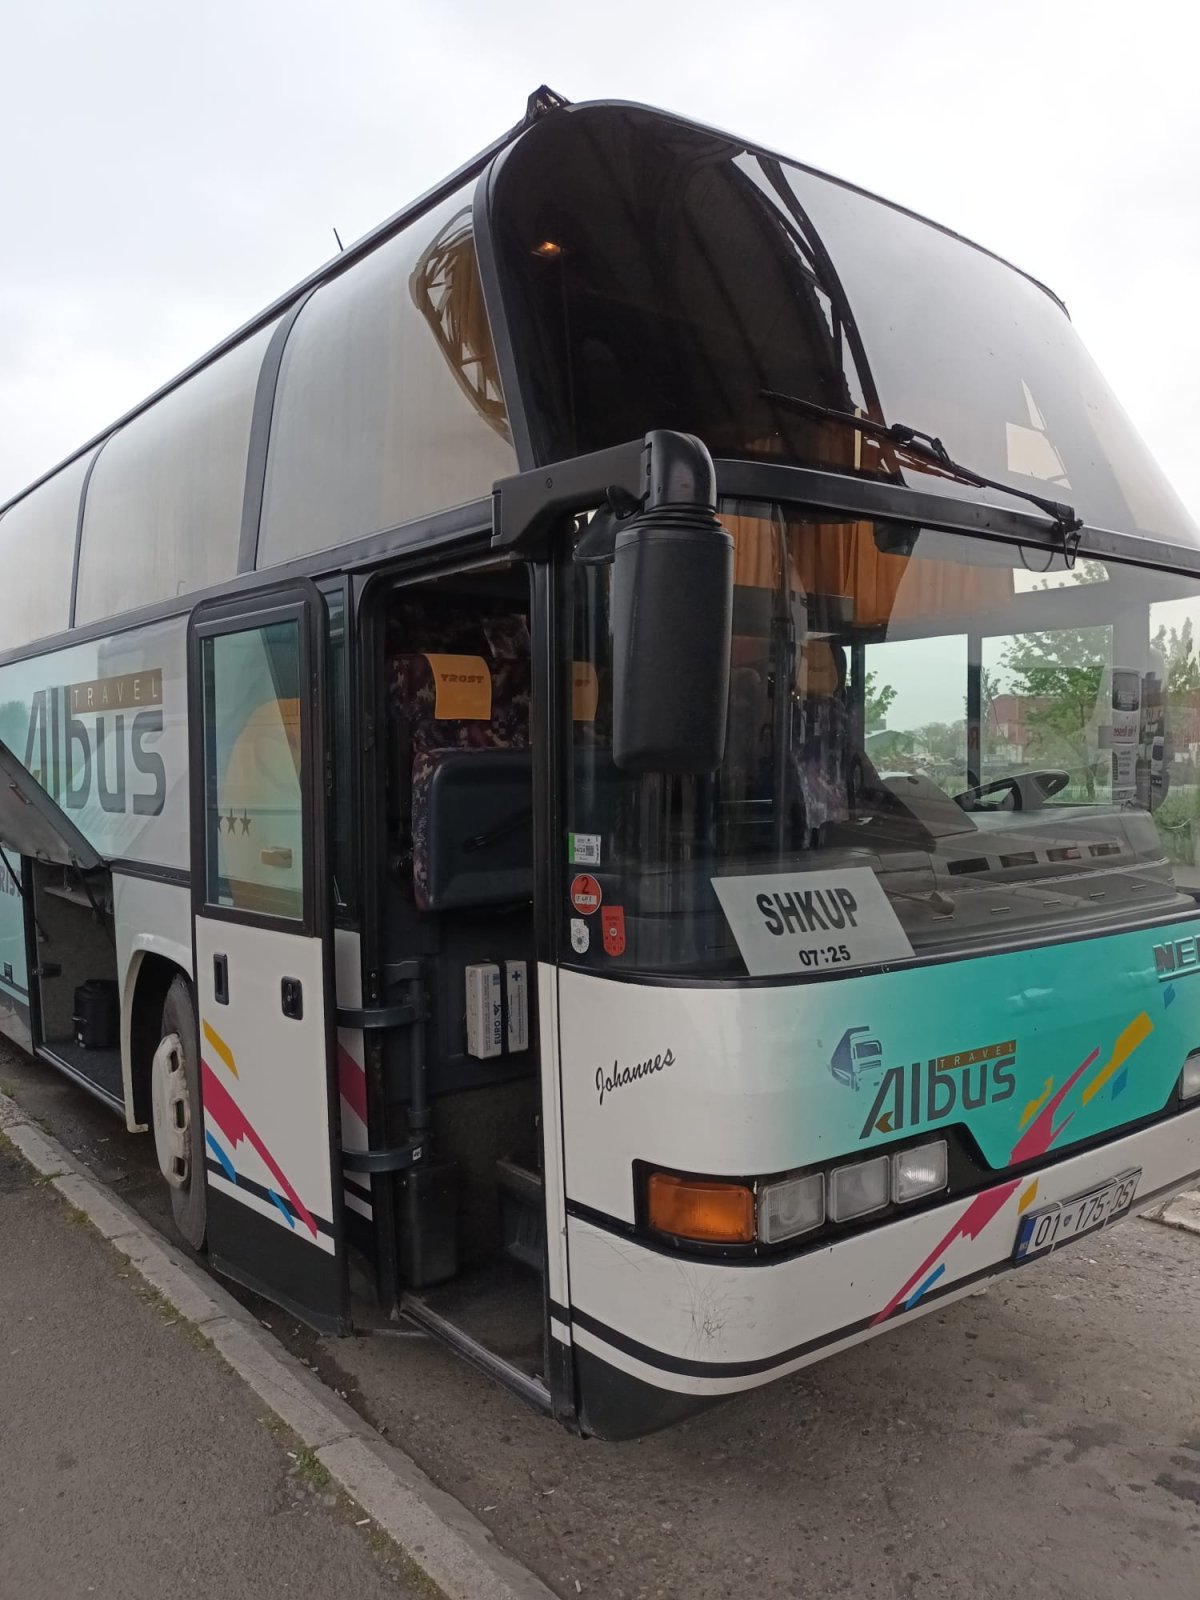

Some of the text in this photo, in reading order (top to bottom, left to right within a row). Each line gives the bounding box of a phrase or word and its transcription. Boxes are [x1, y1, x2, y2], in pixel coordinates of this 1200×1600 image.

[74, 677, 158, 709] TRAVEL
[440, 673, 485, 684] TROST
[24, 686, 167, 816] Albus
[756, 887, 858, 936] SHKUP
[799, 945, 851, 967] 07:25
[1153, 934, 1200, 973] NE
[493, 1020, 502, 1045] EURO
[939, 1043, 1014, 1069] TRAVEL
[596, 1048, 676, 1105] Johannes
[859, 1056, 1016, 1139] Albus
[1035, 1213, 1061, 1247] 01
